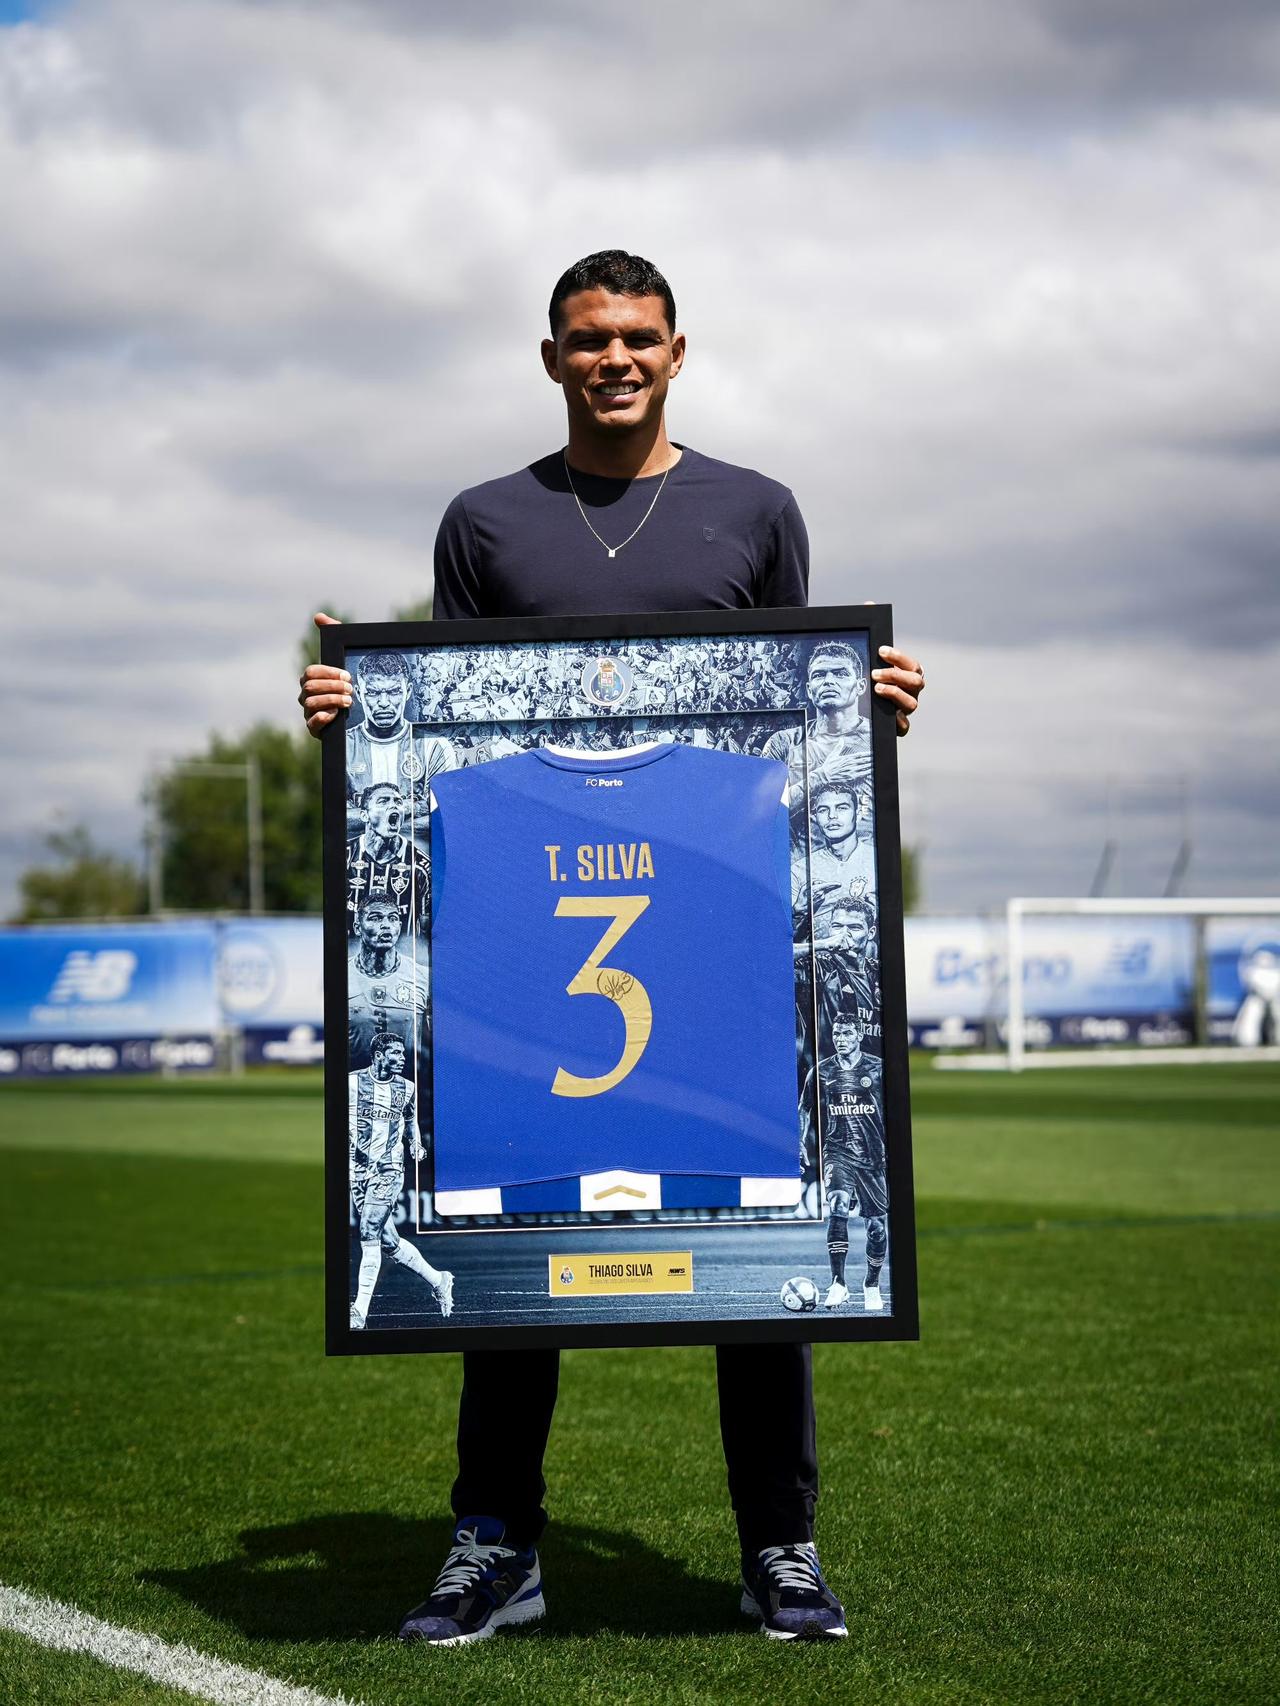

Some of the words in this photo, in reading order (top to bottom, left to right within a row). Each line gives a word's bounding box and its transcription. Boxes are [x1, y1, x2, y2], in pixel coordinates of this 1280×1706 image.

[585, 779, 598, 787] FC
[598, 779, 623, 787] Porto
[544, 845, 567, 881] T.
[577, 842, 655, 881] SILVA
[551, 895, 653, 1098] 3
[857, 1006, 873, 1021] Fly
[841, 1094, 857, 1104] Fly
[828, 1102, 876, 1116] Emirates
[588, 1264, 624, 1278] THIAGO
[625, 1263, 653, 1277] SILVA
